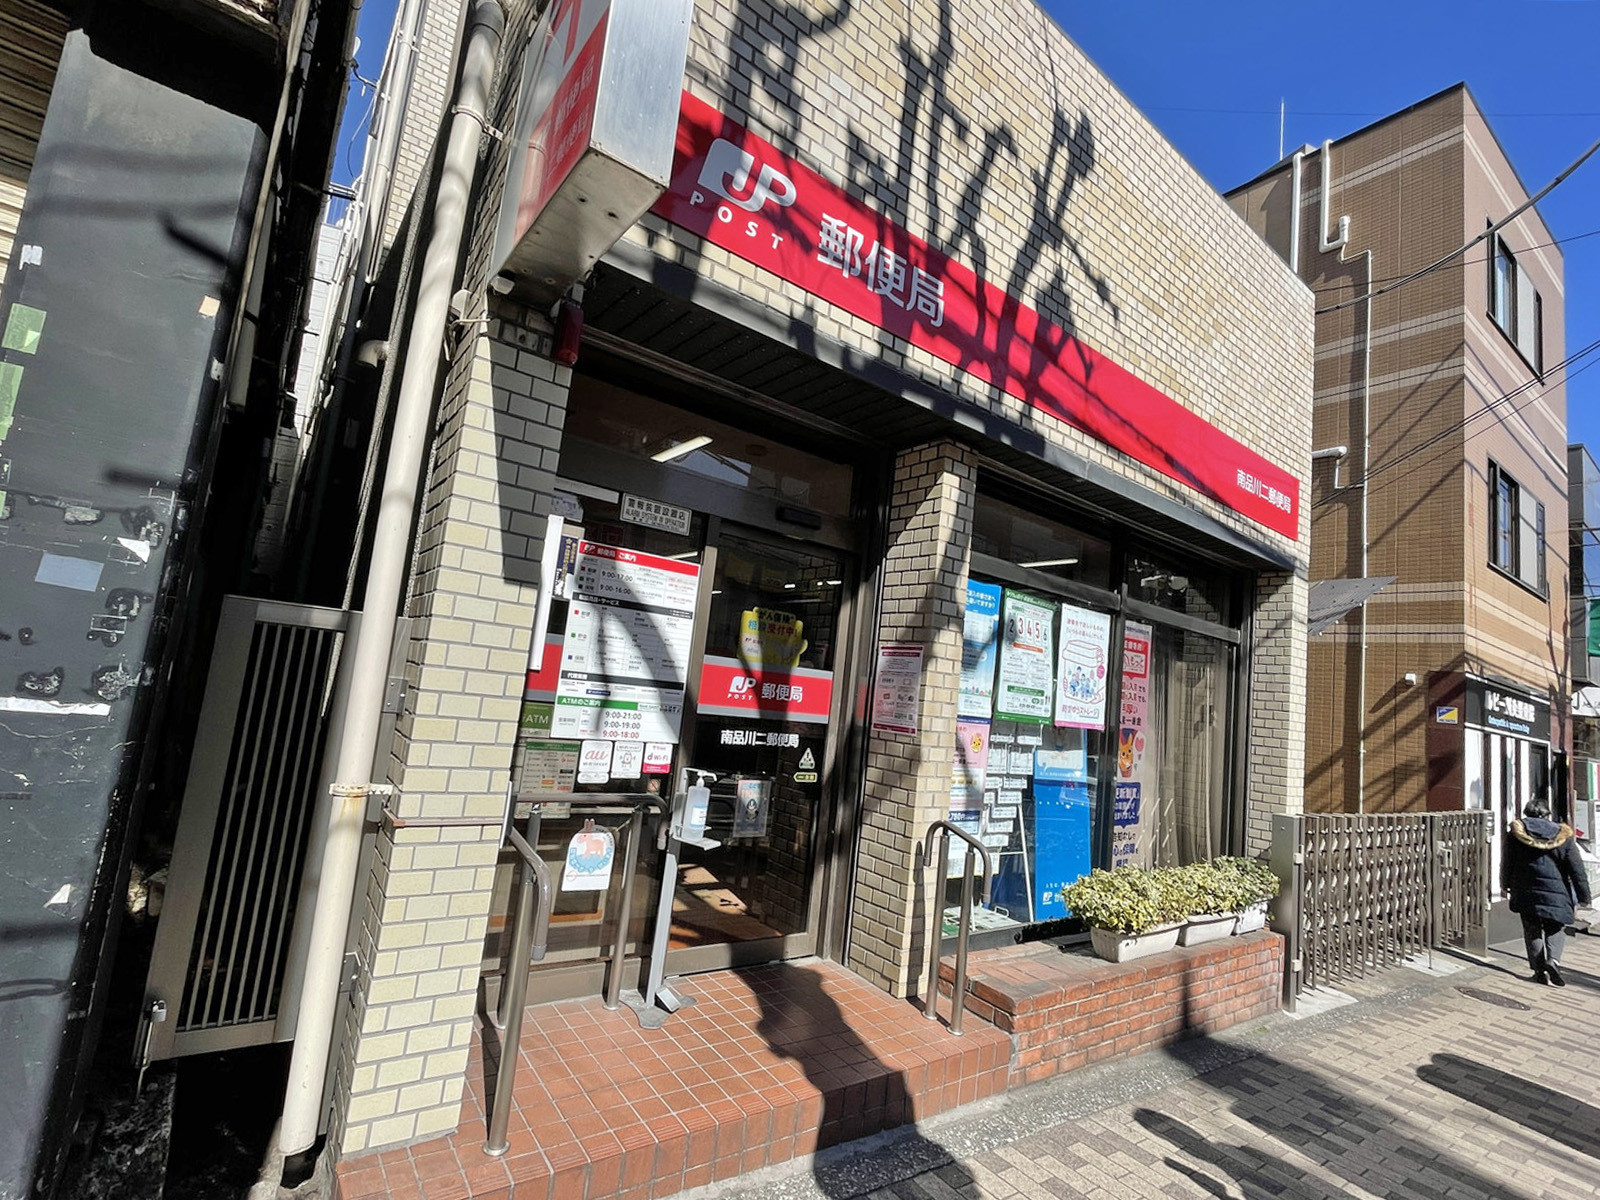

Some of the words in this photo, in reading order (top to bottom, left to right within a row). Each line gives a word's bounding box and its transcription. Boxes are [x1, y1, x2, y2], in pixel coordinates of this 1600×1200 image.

[689, 190, 784, 250] POST
[816, 212, 946, 328] 郵便局
[1236, 469, 1292, 515] 南品川二郵便局
[618, 552, 637, 562] ご案内
[601, 570, 634, 583] 9:00-17:00
[600, 584, 632, 595] 9:00-16:00
[1009, 618, 1015, 633] 2
[1018, 617, 1024, 634] 3
[1027, 620, 1032, 638] 4
[1035, 622, 1040, 639] 5
[727, 693, 754, 701] POST
[761, 682, 803, 704] 郵便局
[561, 697, 602, 707] ATMのご案内
[605, 711, 643, 721] 9:00-21:00
[603, 721, 641, 730] 9:00-19:00
[602, 730, 640, 739] 9:00-18:00
[720, 729, 800, 749] 南品川二郵便局
[585, 750, 609, 760] au
